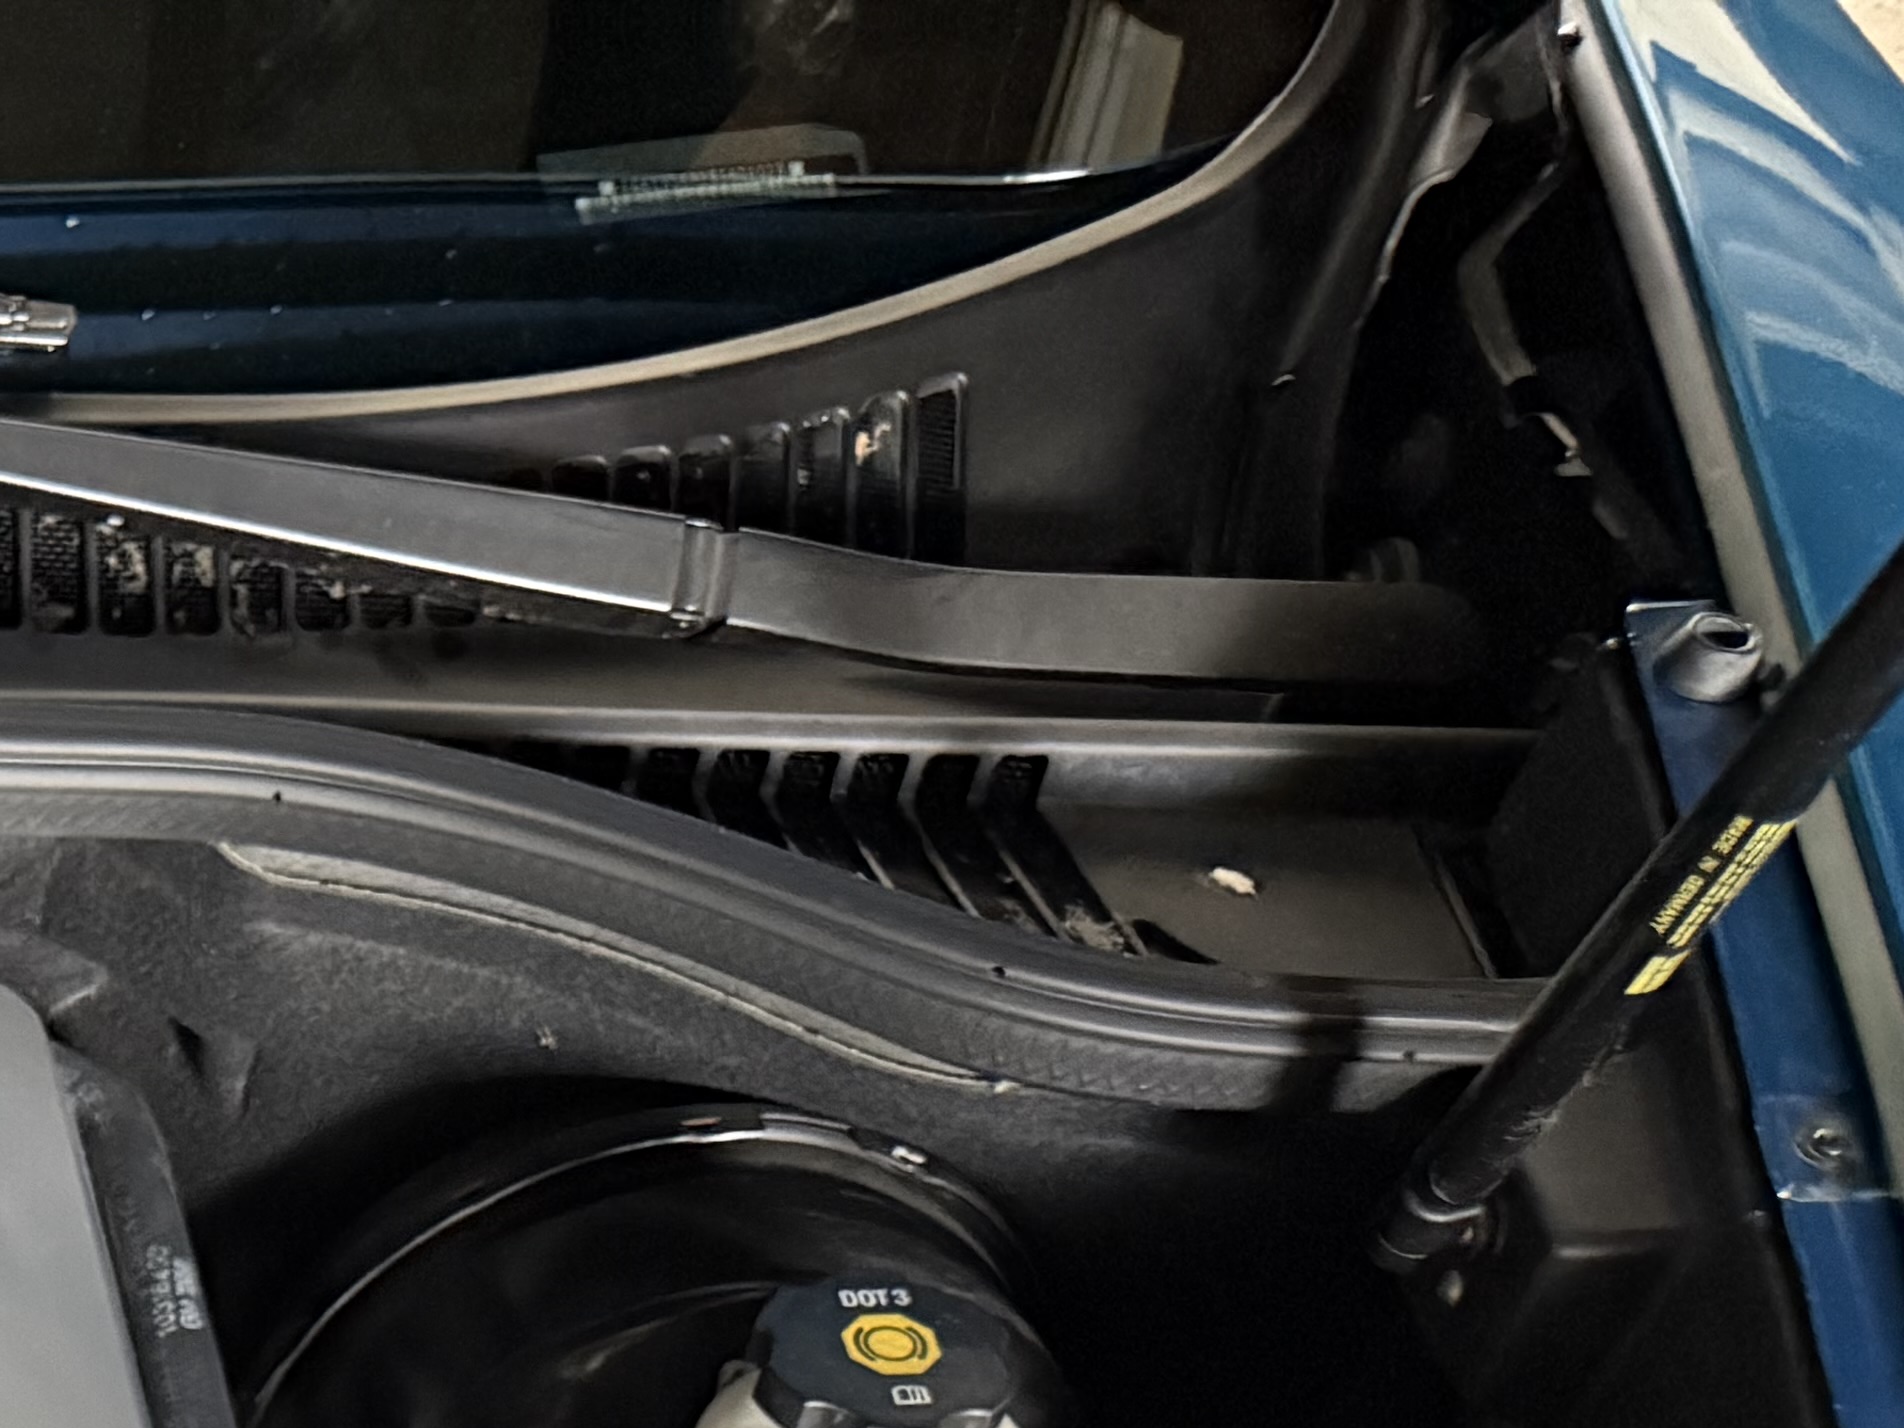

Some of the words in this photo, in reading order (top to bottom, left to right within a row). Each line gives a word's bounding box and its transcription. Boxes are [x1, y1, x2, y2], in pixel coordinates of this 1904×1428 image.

[1649, 874, 1705, 937] GERMANY
[837, 1287, 889, 1307] DOT
[891, 1287, 912, 1307] 3
